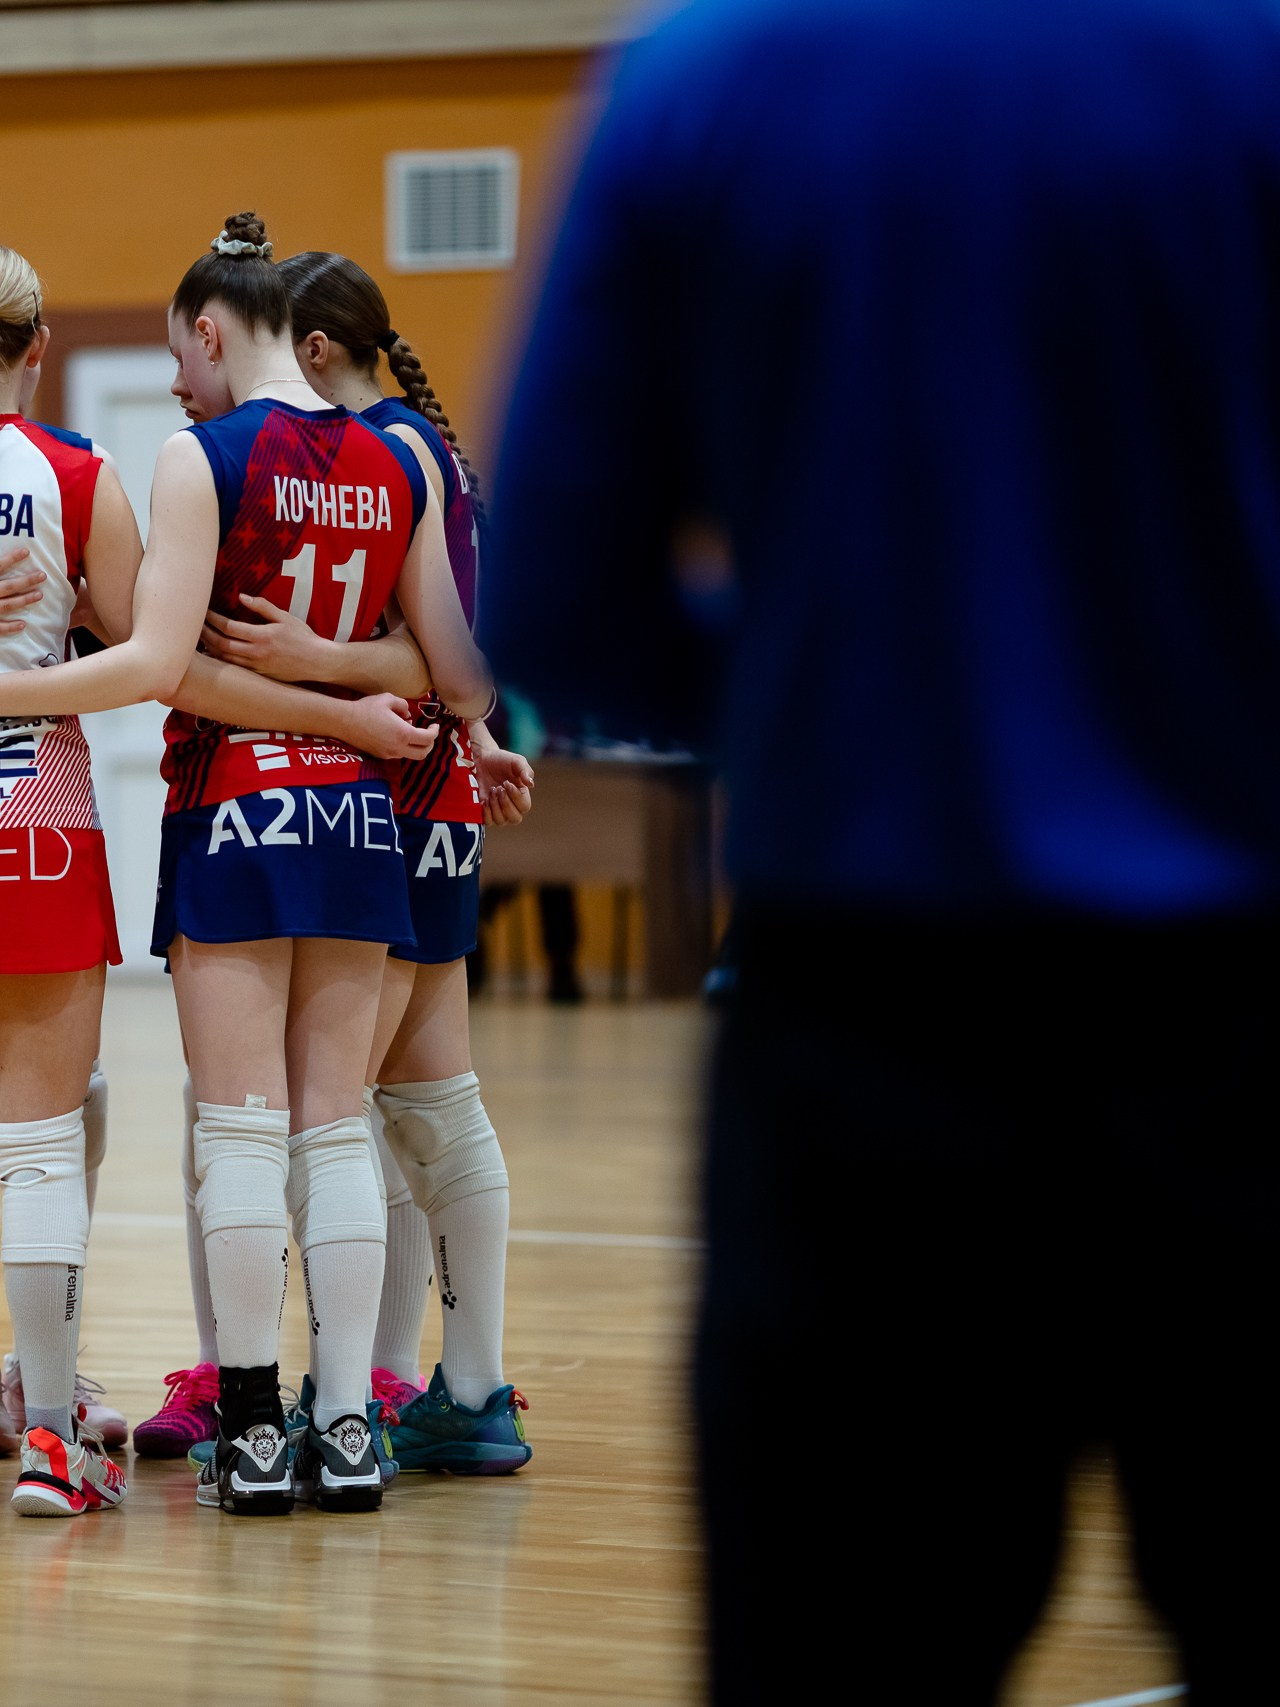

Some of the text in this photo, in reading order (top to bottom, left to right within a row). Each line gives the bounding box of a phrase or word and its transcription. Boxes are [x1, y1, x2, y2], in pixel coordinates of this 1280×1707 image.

[274, 475, 392, 532] КОЧНЕВА
[281, 543, 367, 644] 11
[299, 751, 363, 767] VISION
[65, 1264, 79, 1323] drenalina
